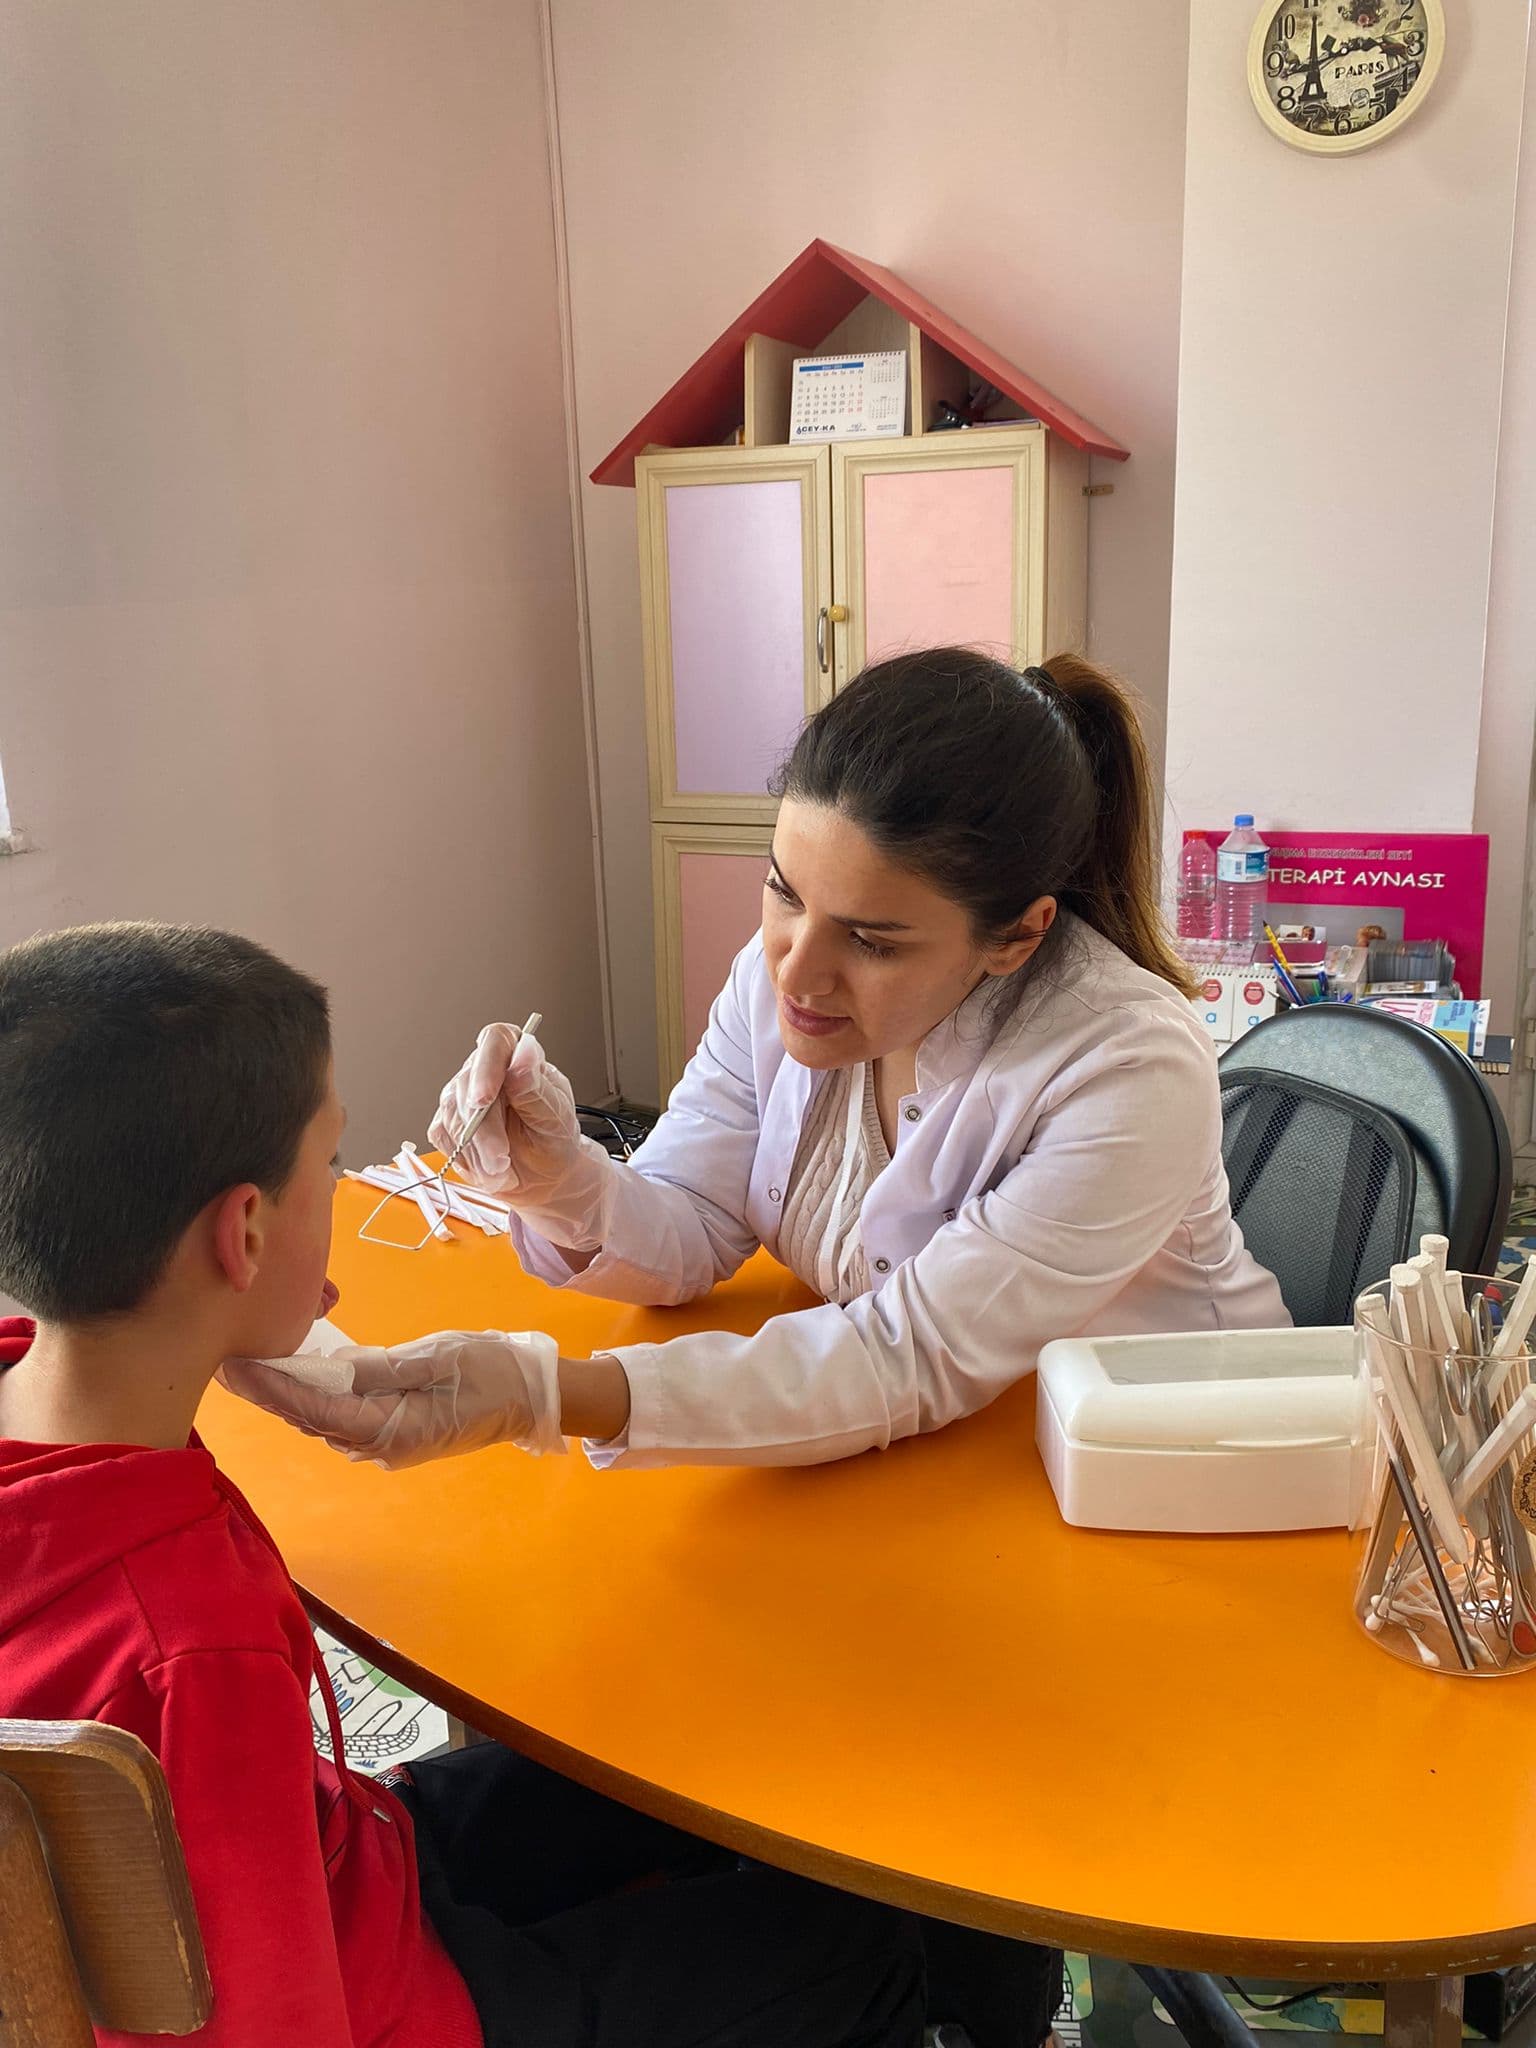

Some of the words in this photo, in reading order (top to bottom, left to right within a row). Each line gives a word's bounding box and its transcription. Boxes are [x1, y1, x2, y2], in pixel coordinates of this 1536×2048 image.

[1278, 14, 1295, 41] 10
[1404, 31, 1424, 56] 3
[1267, 52, 1284, 78] 9
[1335, 61, 1384, 79] PARIS
[1391, 67, 1412, 92] 4
[1277, 86, 1295, 111] 8
[1368, 97, 1386, 121] 5
[1303, 104, 1327, 130] 7
[1334, 111, 1351, 135] 6
[1387, 849, 1413, 861] SETİ
[1268, 868, 1346, 885] TERAPİ
[1353, 871, 1445, 888] AYNASI
